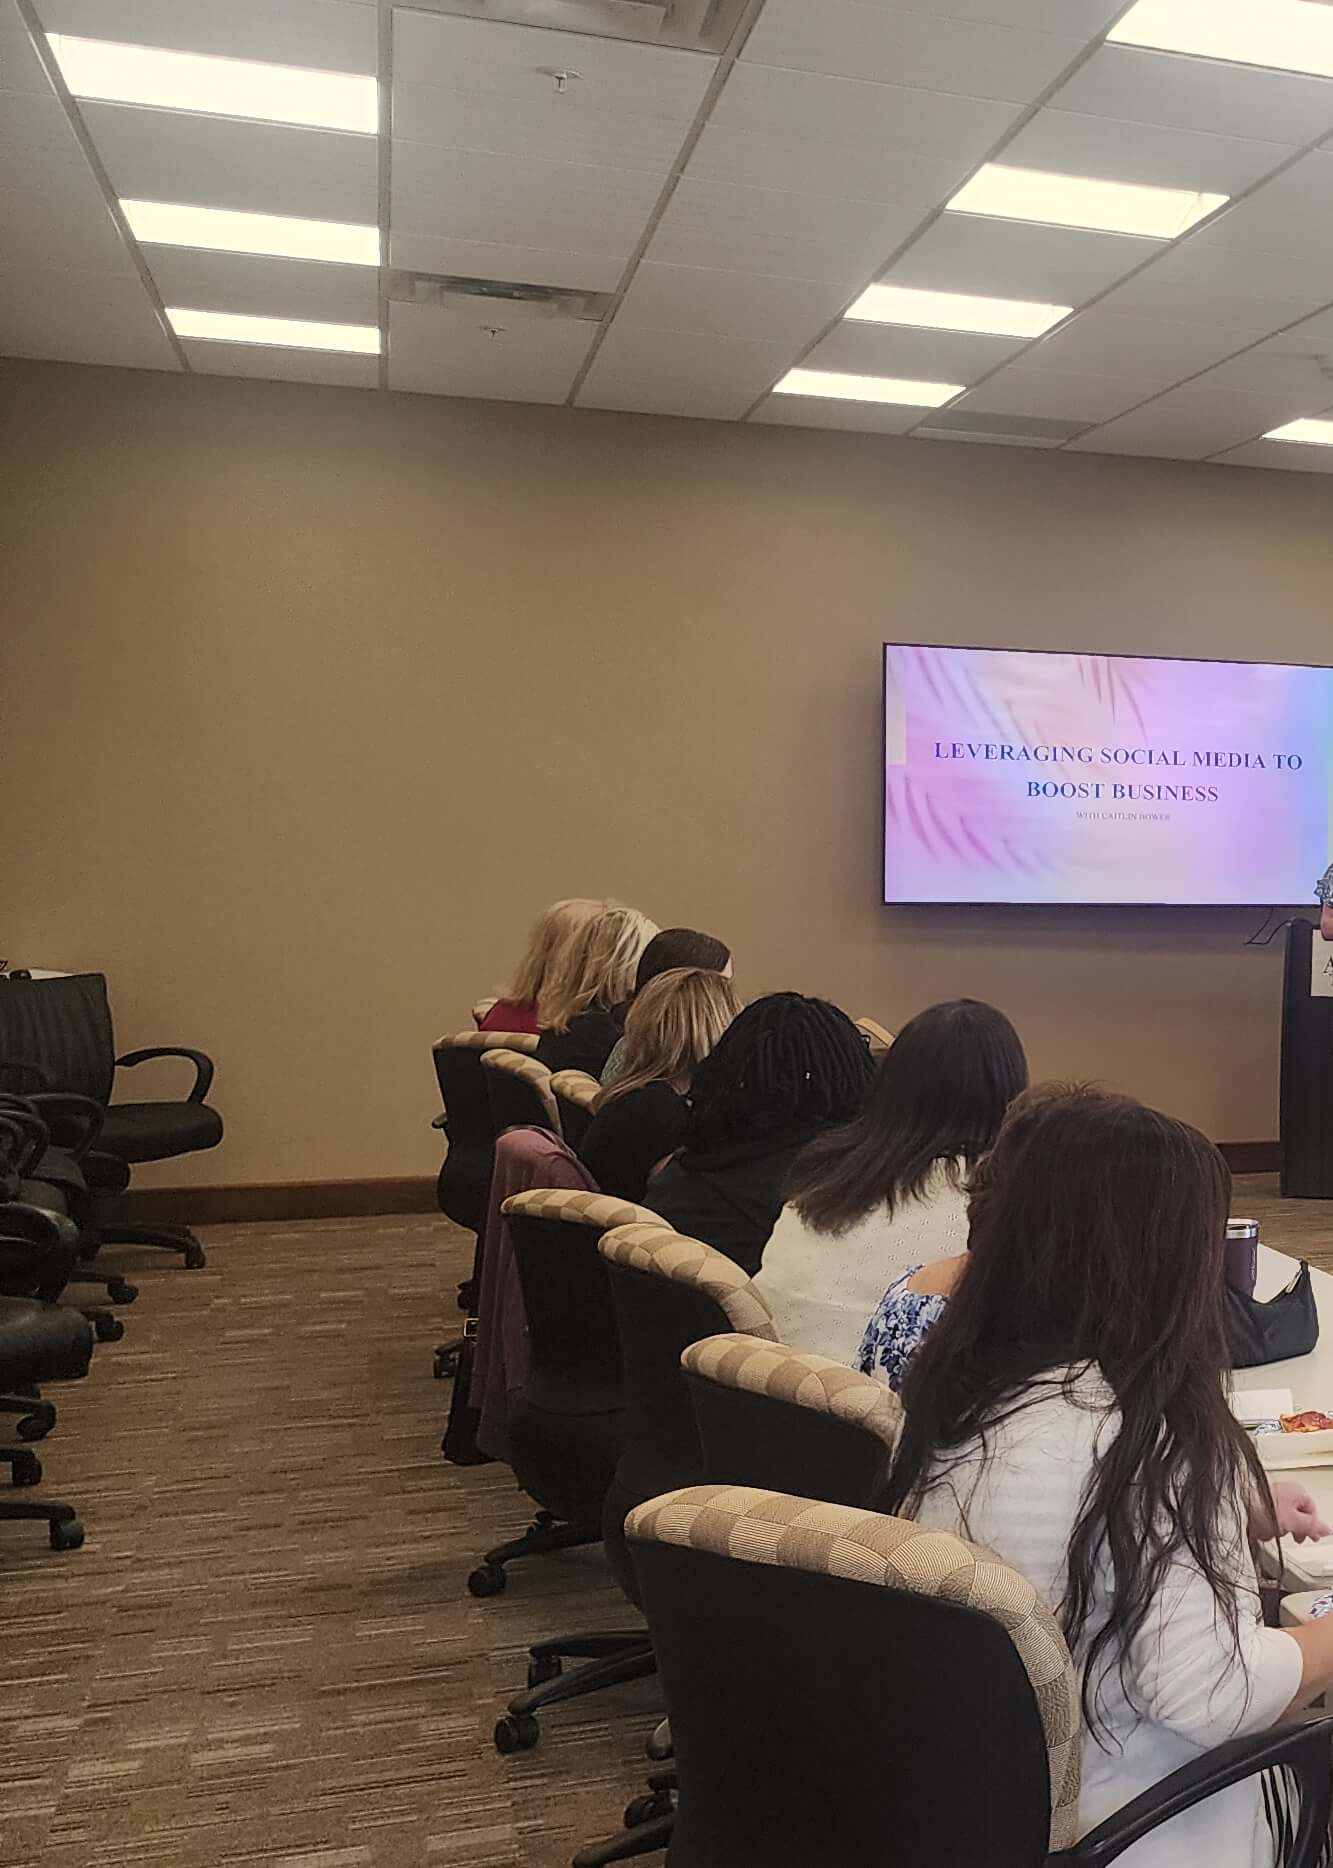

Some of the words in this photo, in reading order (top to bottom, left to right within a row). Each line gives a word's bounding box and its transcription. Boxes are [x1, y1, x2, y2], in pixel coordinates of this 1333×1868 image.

[934, 742, 1093, 763] LEVERAGING
[1100, 747, 1186, 766] SOCIAL
[1193, 751, 1266, 769] MEDIA
[1272, 754, 1303, 770] TO
[1027, 781, 1105, 799] BOOST
[1111, 783, 1219, 802] BUSINESS
